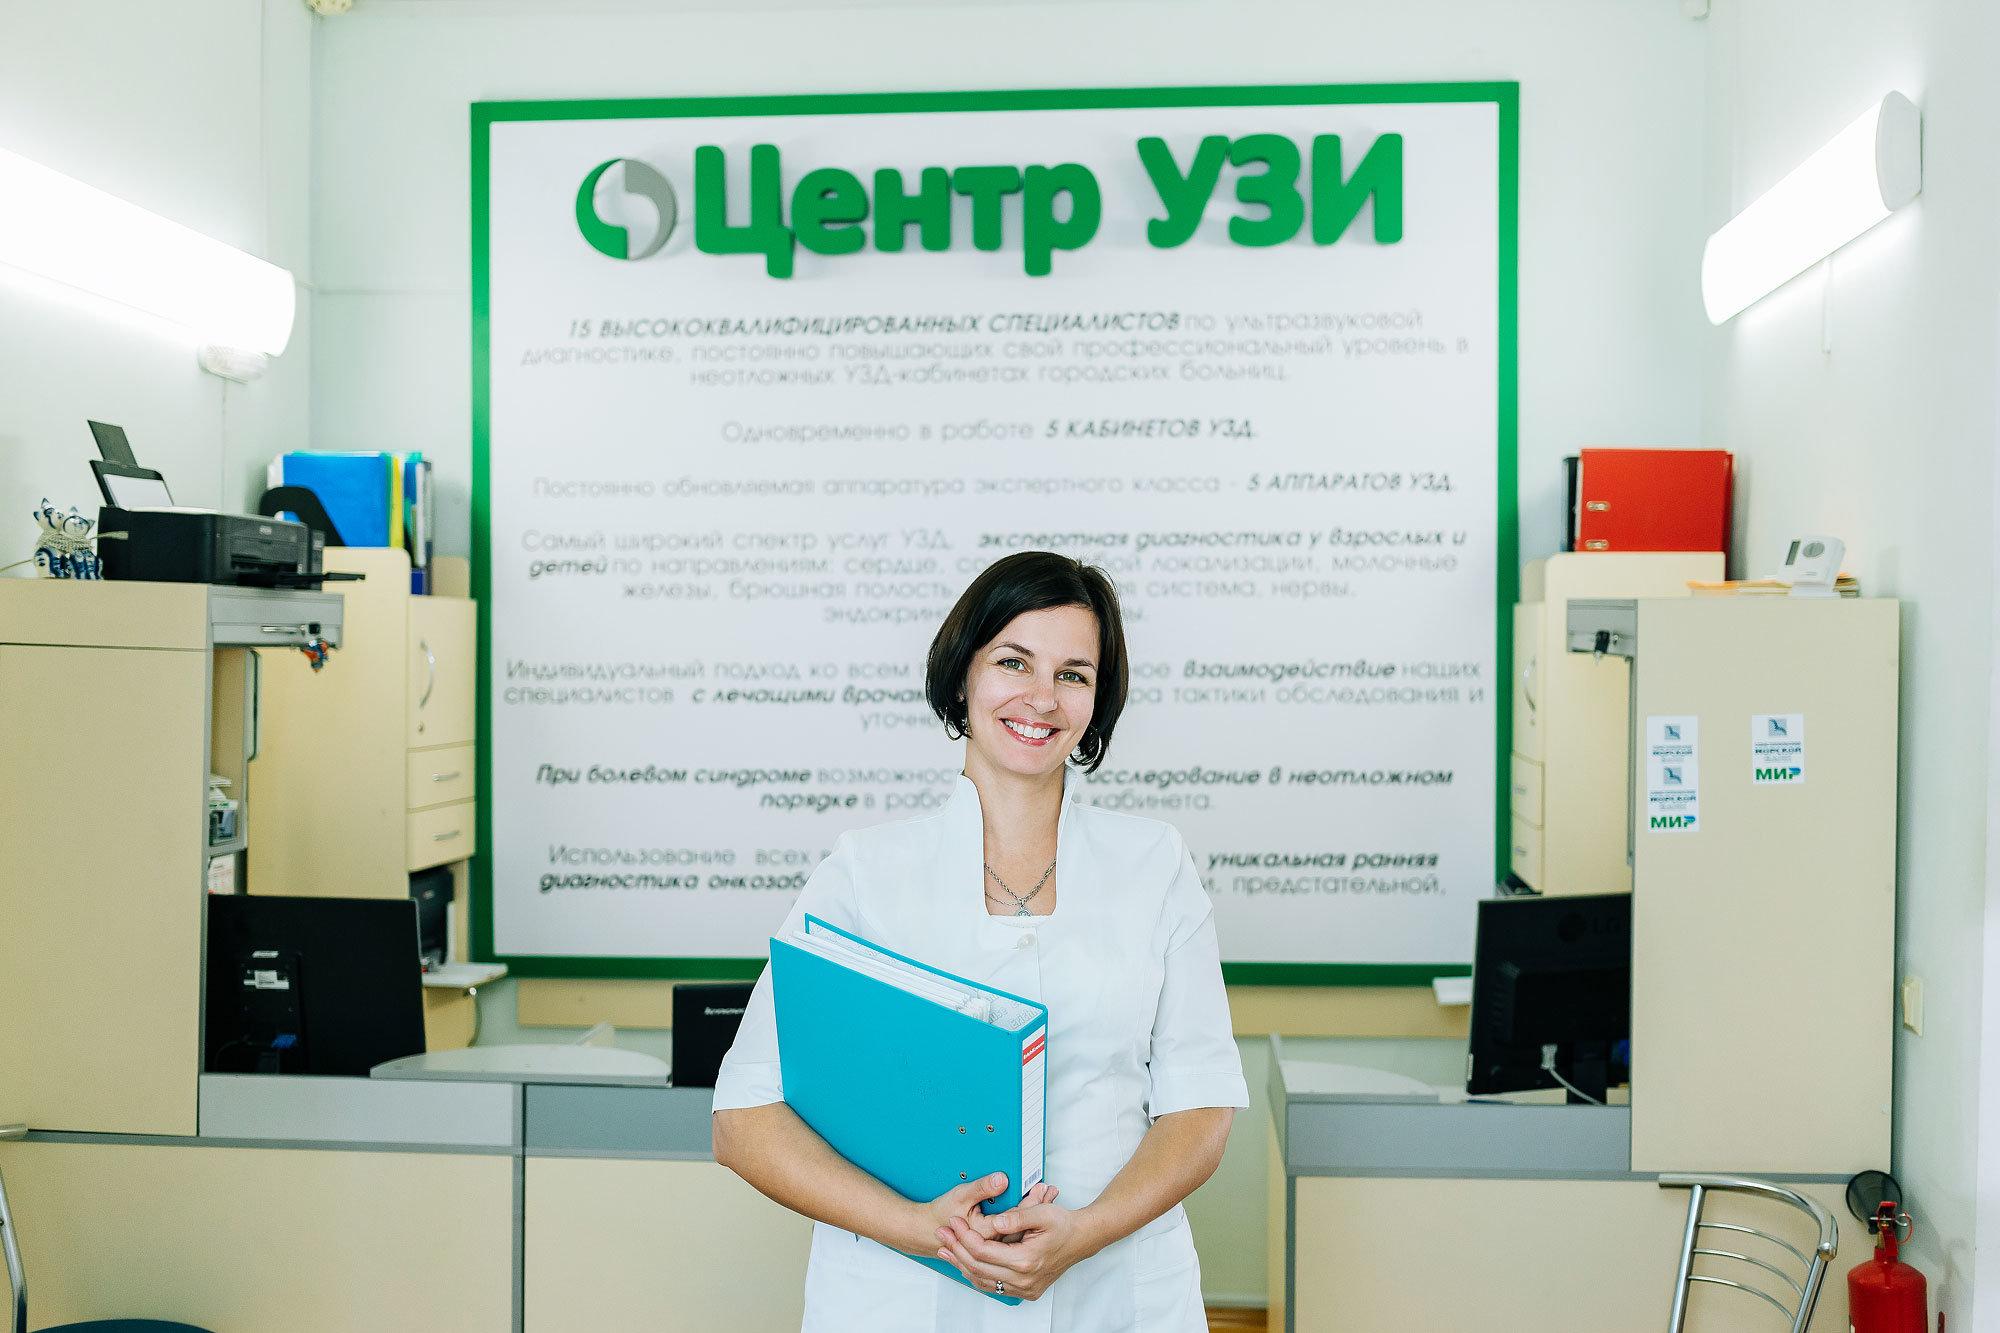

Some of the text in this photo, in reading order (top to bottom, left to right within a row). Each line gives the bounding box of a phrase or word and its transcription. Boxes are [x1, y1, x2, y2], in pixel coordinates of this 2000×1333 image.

[695, 133, 1403, 277] Центр УЗИ
[569, 310, 1423, 338] 15 ВЫСОКОКВАЛИФИЦИРОВАННЫХ СПЕЦИАЛИСТОВ по ультразвуковой
[691, 343, 820, 362] постоянно
[829, 342, 993, 362] повышающих
[1003, 337, 1063, 355] свой
[1074, 335, 1332, 359] профессиональный
[1343, 335, 1447, 357] уровень
[1457, 338, 1470, 353] в
[690, 367, 834, 385] неотложных
[1038, 364, 1170, 384] городских
[721, 421, 911, 444] Одновременно
[919, 424, 931, 440] в
[941, 419, 1033, 443] работе
[1046, 420, 1059, 437] 5
[1065, 419, 1201, 438] КАБИНЕТОВ
[533, 477, 656, 498] Постоянно
[663, 474, 815, 497] обновляемая
[823, 478, 965, 497] аппаратура
[975, 477, 1123, 497] экспертного
[1133, 477, 1220, 492] класса
[1247, 474, 1260, 491] 5
[1266, 473, 1401, 492] АППАРАТОВ
[522, 529, 605, 550] Самый
[615, 529, 724, 551] широкий
[733, 532, 817, 551] спектр
[827, 533, 888, 553] услуг
[1135, 531, 1302, 551] диагностика
[1309, 531, 1321, 549] у
[1329, 527, 1447, 548] взрослых
[1454, 531, 1466, 545] и
[530, 555, 608, 578] детей
[612, 559, 640, 573] по
[1332, 555, 1458, 572] молочные
[729, 574, 847, 598] брюшная
[506, 658, 705, 681] Индивидуальный
[715, 660, 800, 681] подход
[810, 662, 838, 678] ко
[848, 662, 910, 678] всем
[1184, 659, 1395, 681] взаимодействие
[1402, 663, 1480, 678] наших
[503, 686, 675, 705] специалистов
[692, 688, 705, 702] с
[713, 688, 836, 703] лечащими
[1173, 687, 1263, 703] тактики
[1276, 684, 1458, 704] обследования
[1469, 687, 1483, 703] и
[537, 764, 581, 784] При
[588, 765, 687, 784] болевом
[694, 768, 812, 787] синдроме
[1269, 767, 1280, 784] в
[1289, 769, 1454, 785] неотложном
[1755, 767, 1801, 780] МИР
[760, 792, 857, 811] порядке
[864, 795, 876, 808] в
[1651, 815, 1696, 828] МИР
[548, 845, 735, 866] Использование
[755, 850, 811, 866] всех
[1208, 852, 1346, 871] уникальная
[1352, 854, 1438, 870] ранняя
[540, 874, 699, 893] диагностика
